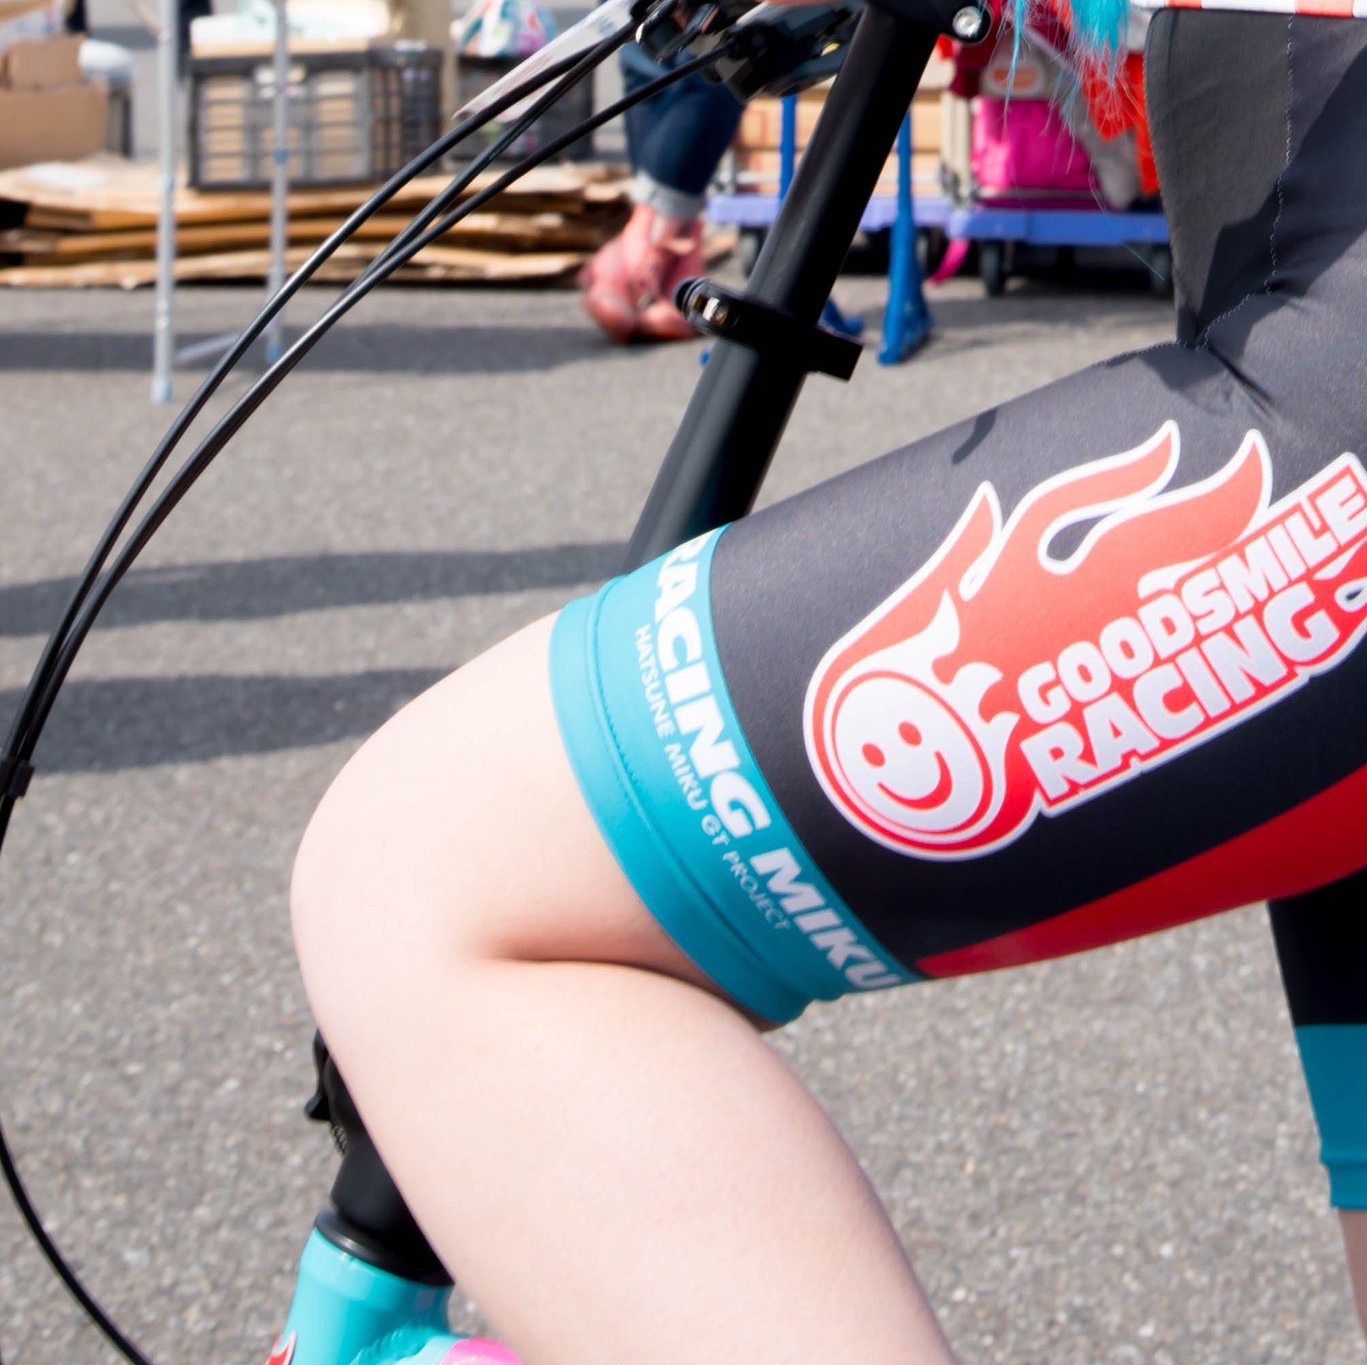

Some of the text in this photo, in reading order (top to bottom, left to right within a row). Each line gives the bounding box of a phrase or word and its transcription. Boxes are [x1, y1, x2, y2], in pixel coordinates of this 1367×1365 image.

[634, 624, 791, 932] HATSUNE MIKU GT PROJECT
[1019, 581, 1341, 800] RACING
[749, 847, 900, 991] MIKU
